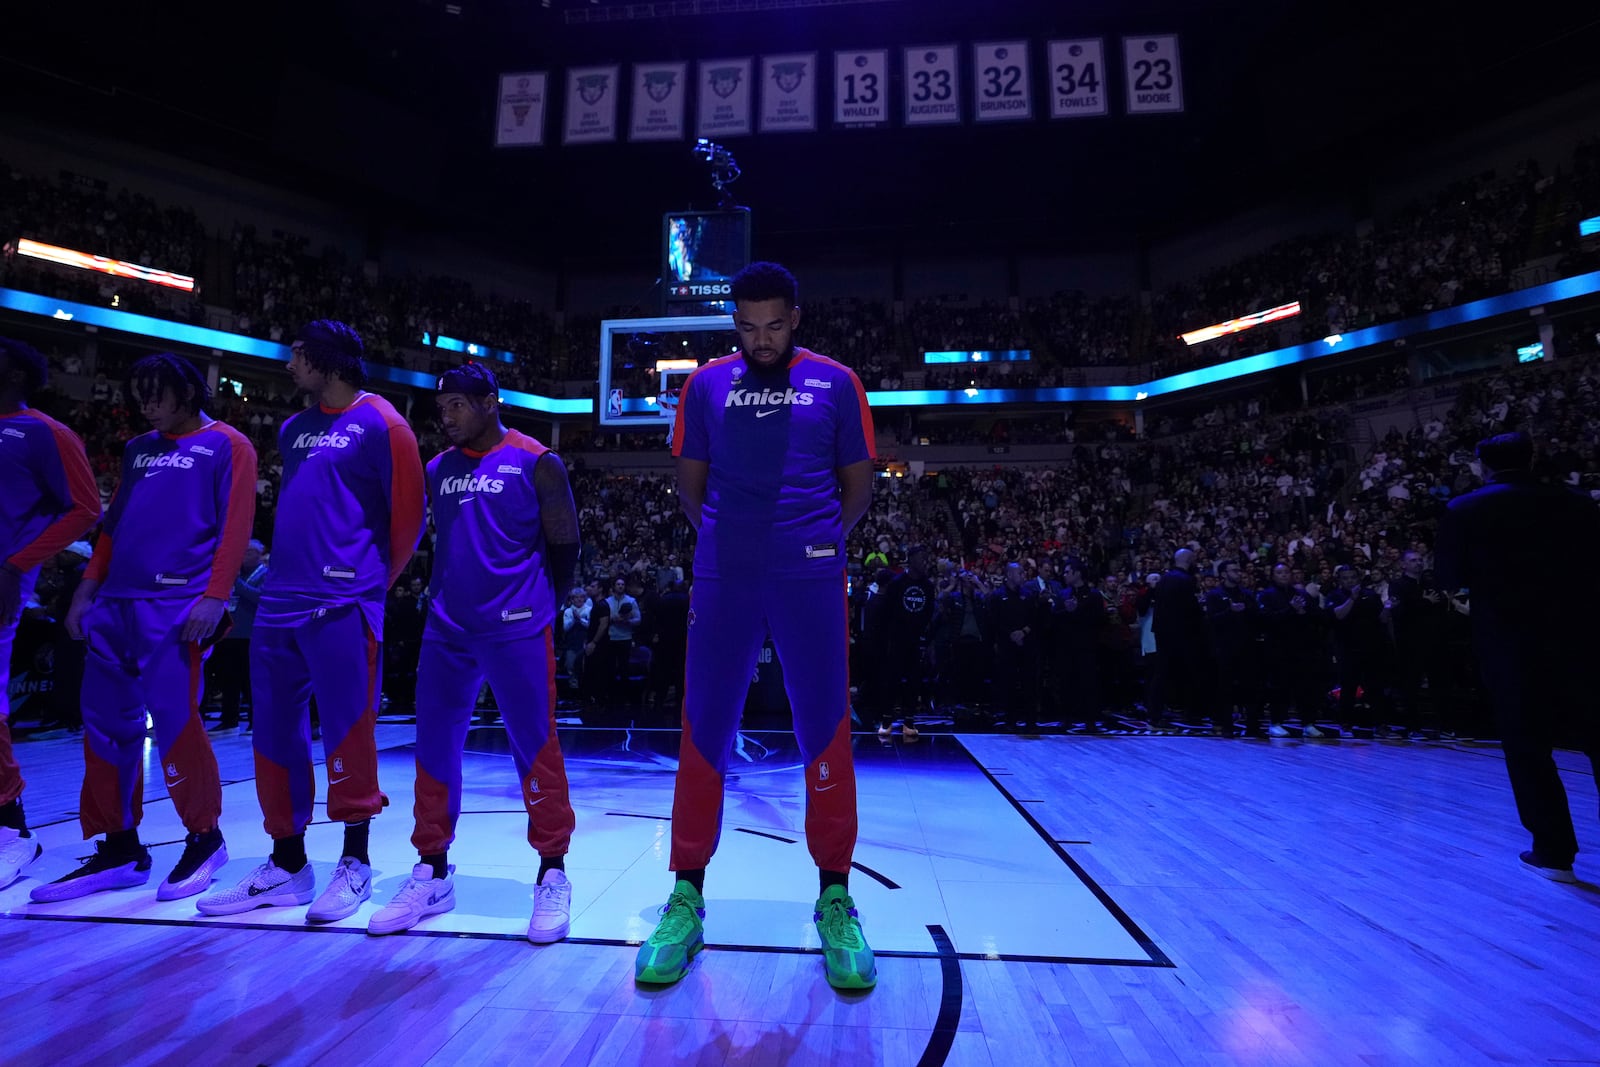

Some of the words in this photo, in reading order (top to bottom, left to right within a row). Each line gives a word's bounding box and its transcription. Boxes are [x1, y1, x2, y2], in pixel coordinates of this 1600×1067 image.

[983, 65, 1022, 98] 32
[1056, 62, 1100, 95] 34
[1133, 59, 1173, 91] 23
[843, 73, 879, 104] 13
[913, 69, 952, 102] 33
[980, 99, 1026, 112] BRUNSON
[1059, 96, 1098, 108] FOWLES
[1137, 93, 1171, 104] MOORE
[842, 106, 880, 117] WHALEN
[910, 103, 956, 115] AUGUSTUS
[689, 284, 732, 296] TISSO
[724, 387, 814, 408] Knicks
[292, 431, 350, 449] Knicks
[132, 452, 195, 469] Knicks
[440, 473, 505, 496] Knicks
